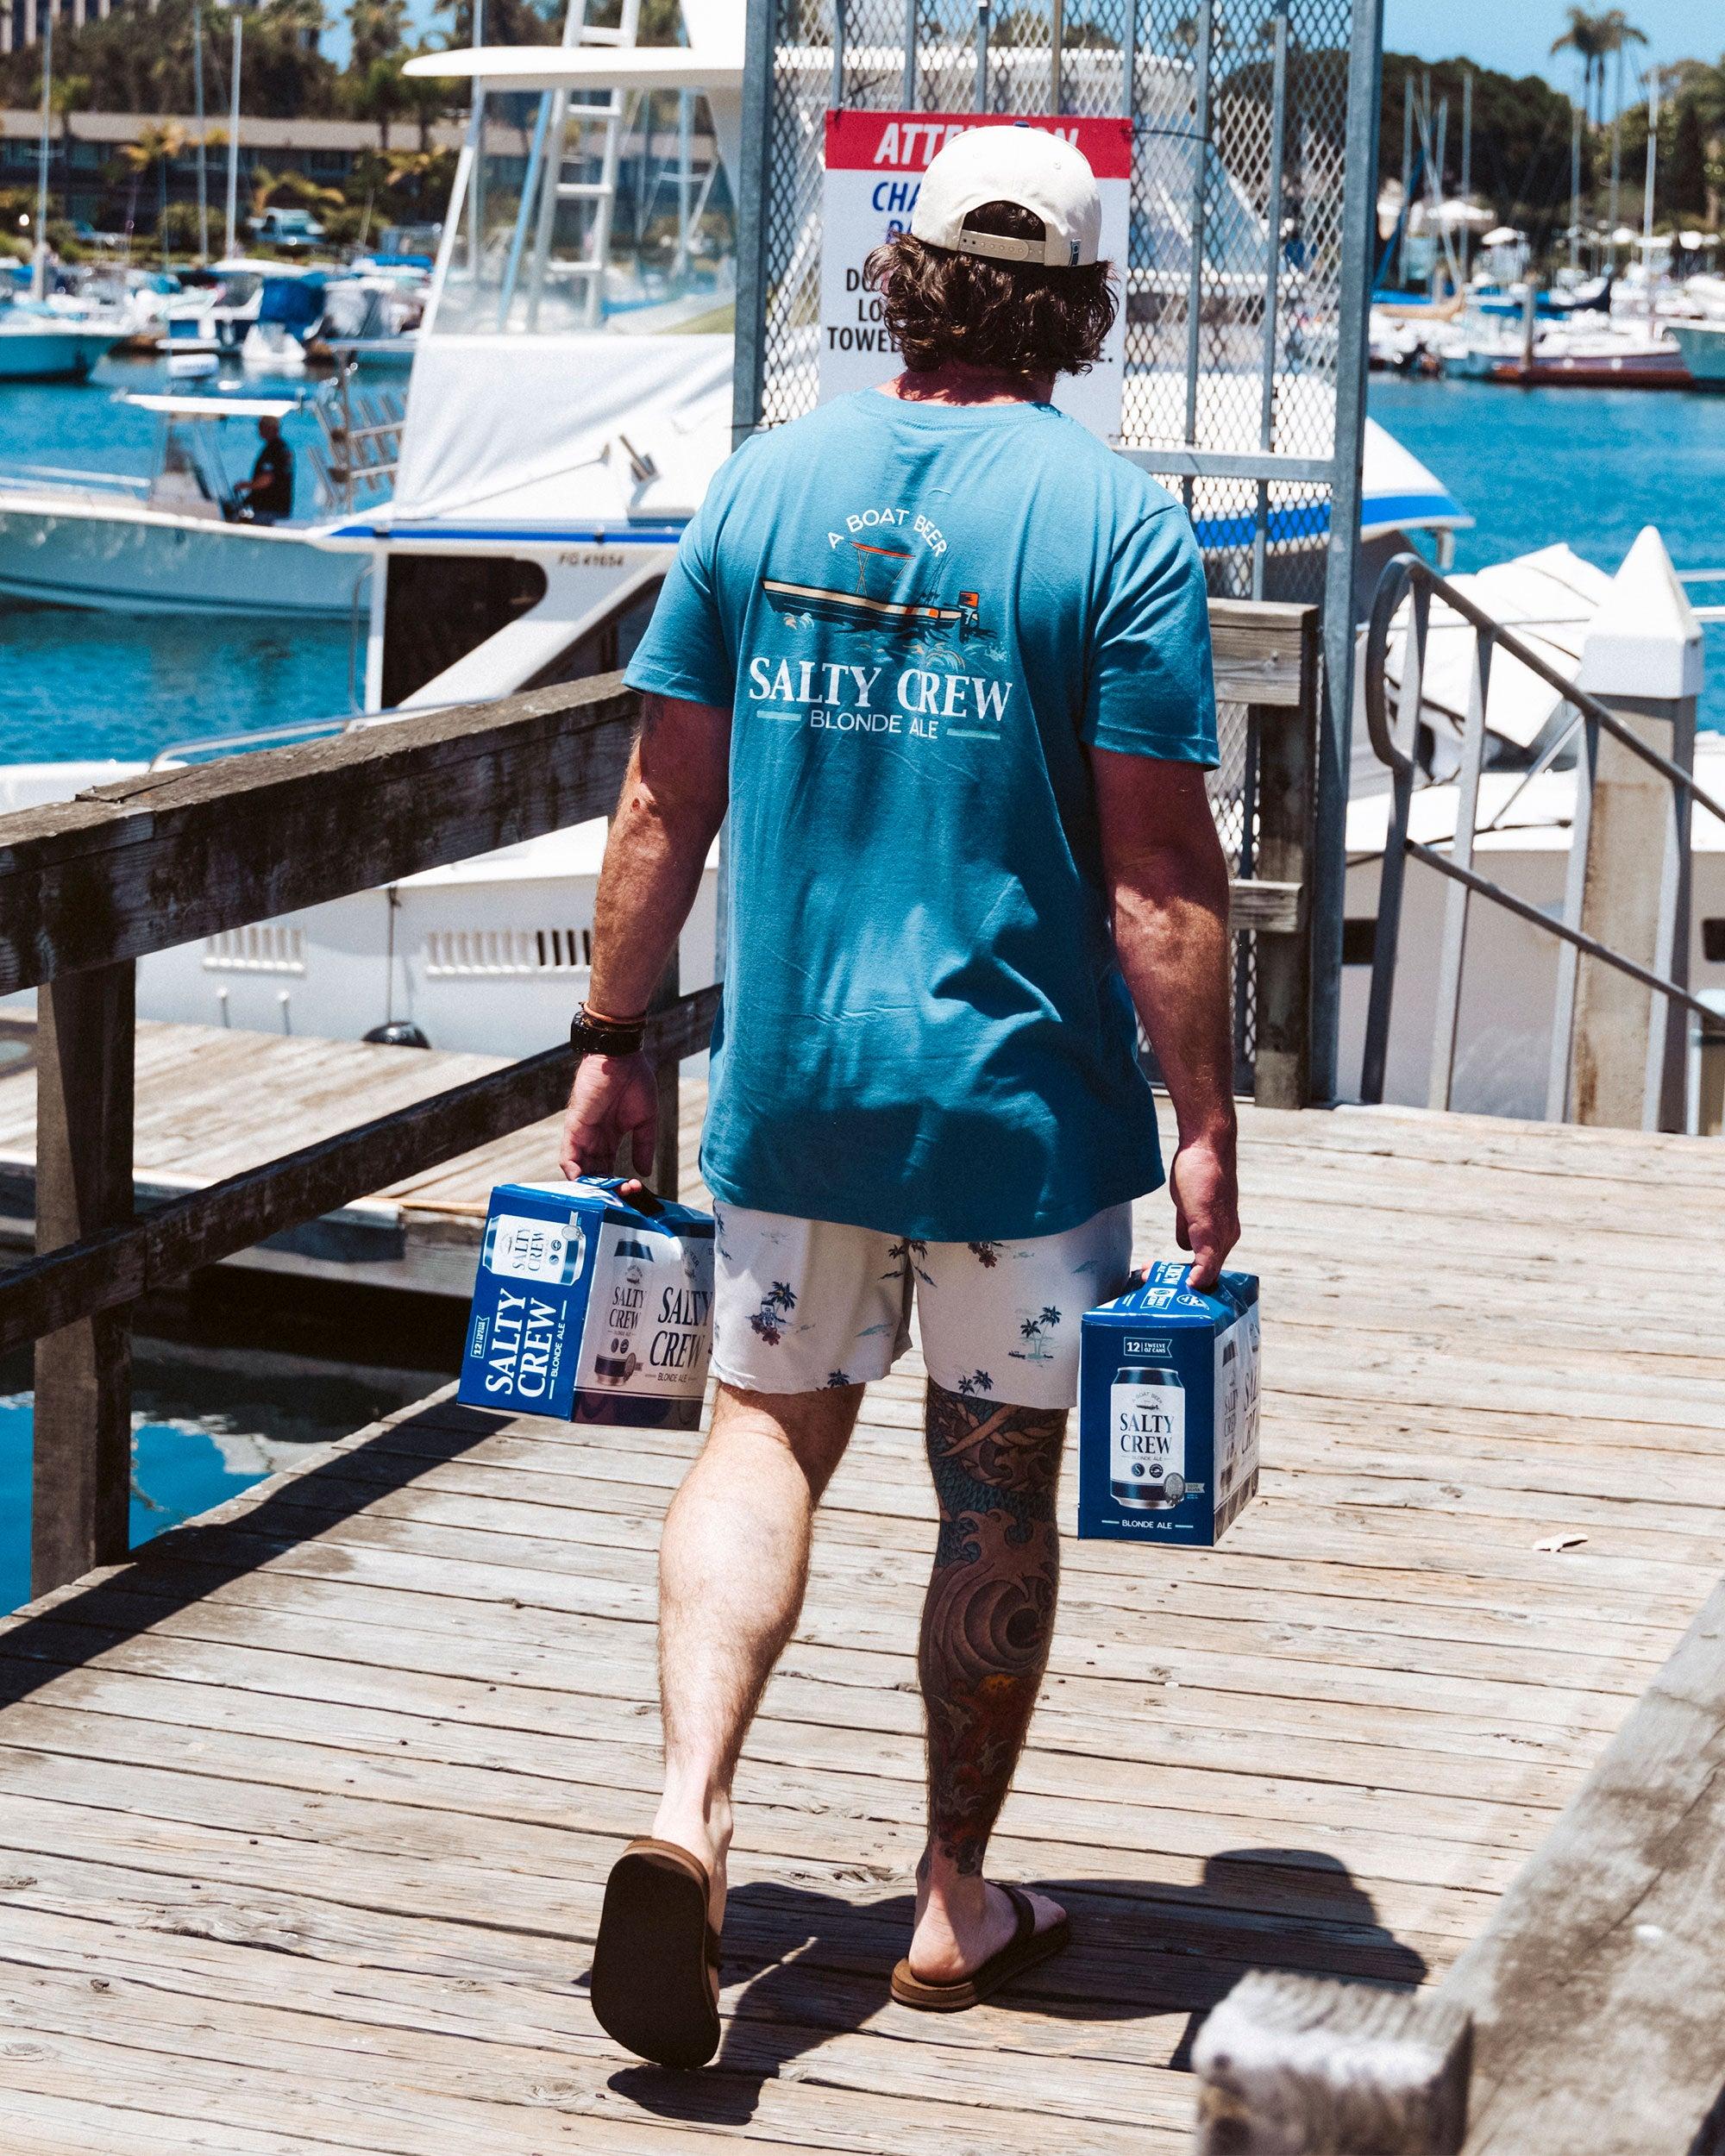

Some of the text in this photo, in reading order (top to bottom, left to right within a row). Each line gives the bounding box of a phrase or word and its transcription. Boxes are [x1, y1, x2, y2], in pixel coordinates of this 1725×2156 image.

[827, 508, 948, 558] A BOAT BEER
[749, 657, 1013, 721] SALTY CREW
[810, 710, 939, 740] BLONDE ALE
[512, 1228, 531, 1270] SALTY
[528, 1230, 544, 1271] CREW
[612, 1286, 647, 1308] SALTY
[658, 1287, 713, 1327] SALTY
[609, 1308, 641, 1330] CREW
[485, 1288, 526, 1395] SALTY
[518, 1297, 556, 1398] CREW
[551, 1323, 566, 1377] BLONDE ALE
[649, 1330, 706, 1369] CREW
[1126, 1341, 1140, 1352] 12
[657, 1372, 687, 1383] BLONDE ALE
[1120, 1413, 1174, 1433] SALTY
[1120, 1434, 1172, 1454] CREW
[1121, 1519, 1172, 1530] BLONDE ALE
